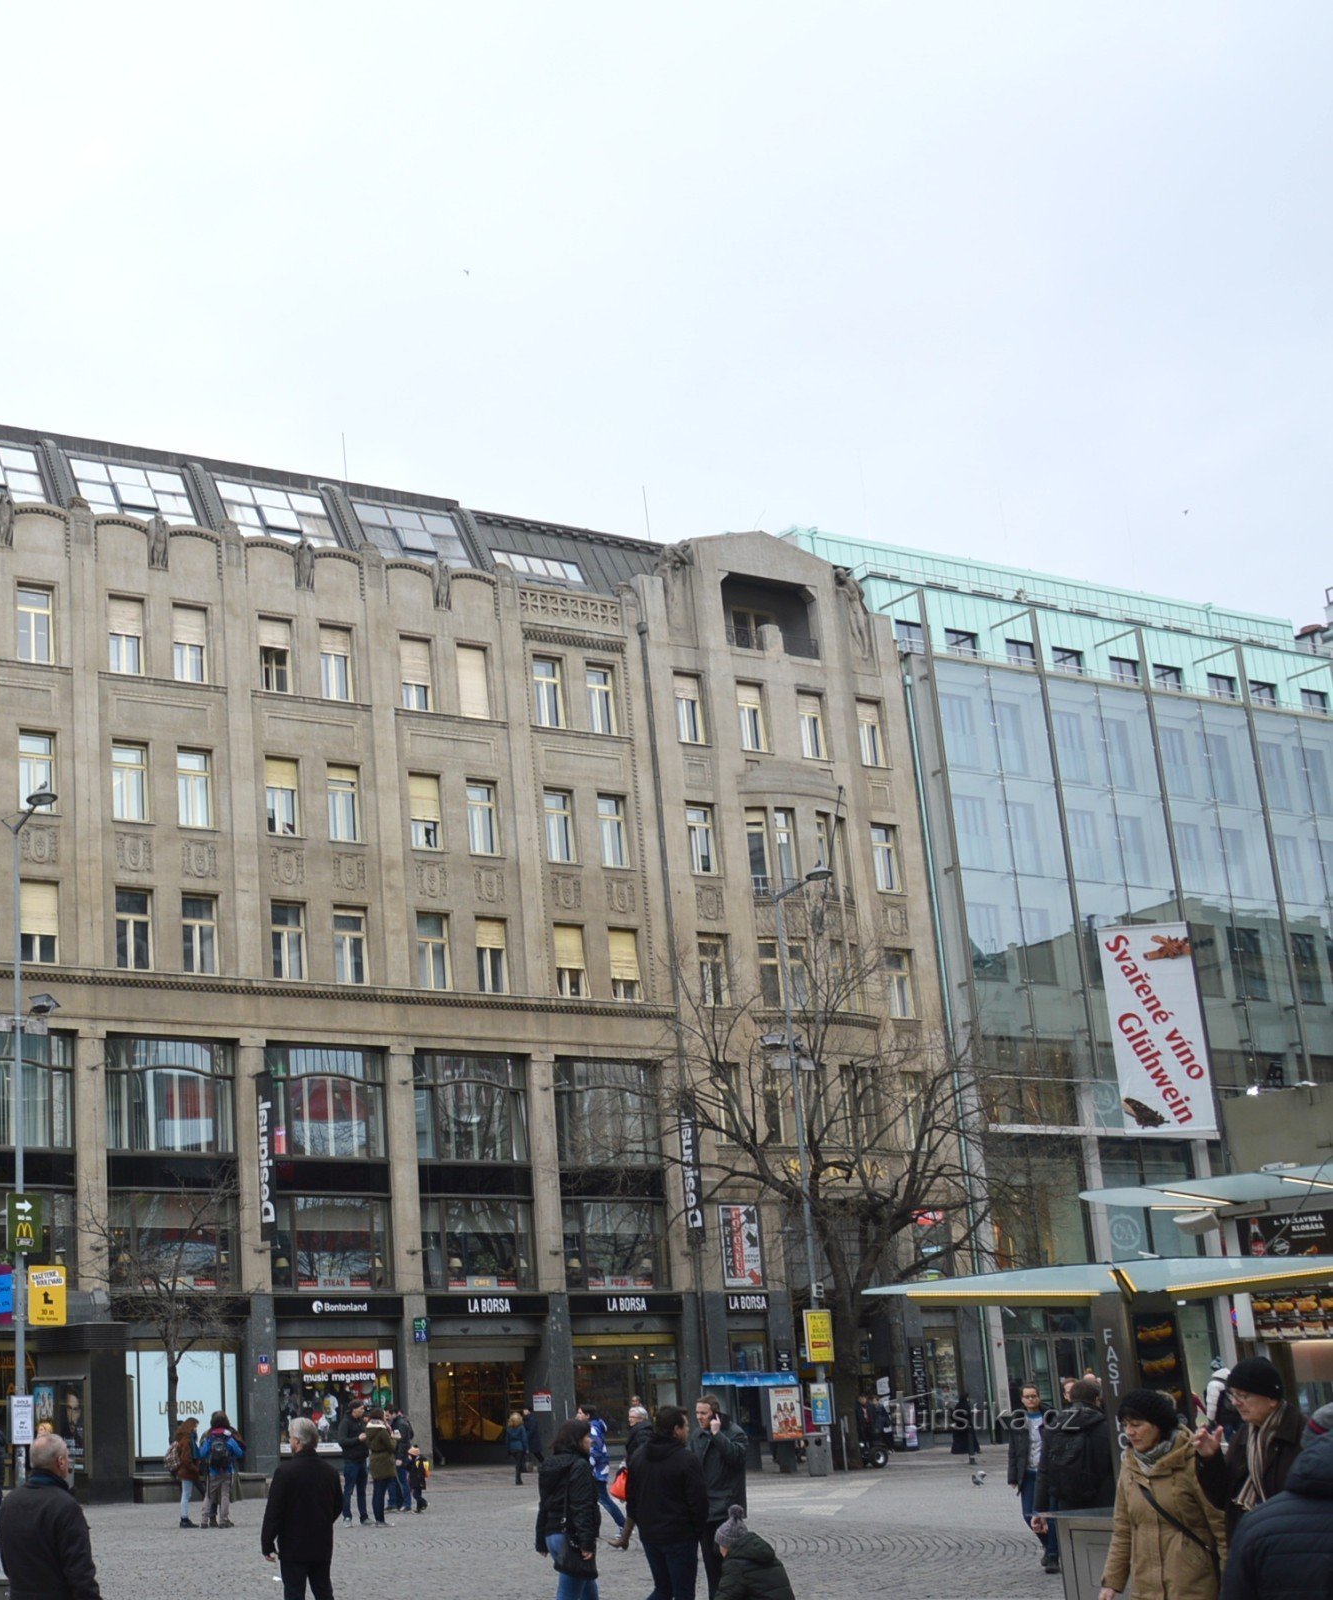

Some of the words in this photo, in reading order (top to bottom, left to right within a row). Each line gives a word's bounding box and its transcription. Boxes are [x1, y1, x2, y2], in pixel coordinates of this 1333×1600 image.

[1105, 934, 1175, 1025] Svařené
[1164, 1028, 1205, 1080] víno
[1118, 1012, 1193, 1124] Glühwein
[323, 1279, 345, 1287] STEAK
[324, 1302, 368, 1312] Bontonland
[468, 1298, 479, 1313] LA
[481, 1298, 511, 1313] BORSA
[606, 1297, 618, 1311] LA
[619, 1297, 647, 1311] BORSA
[728, 1295, 739, 1310] LA
[740, 1295, 767, 1310] BORSA
[319, 1353, 373, 1364] Bontonland
[1103, 1328, 1119, 1397] FAST
[303, 1372, 329, 1382] music
[331, 1372, 376, 1383] megastore
